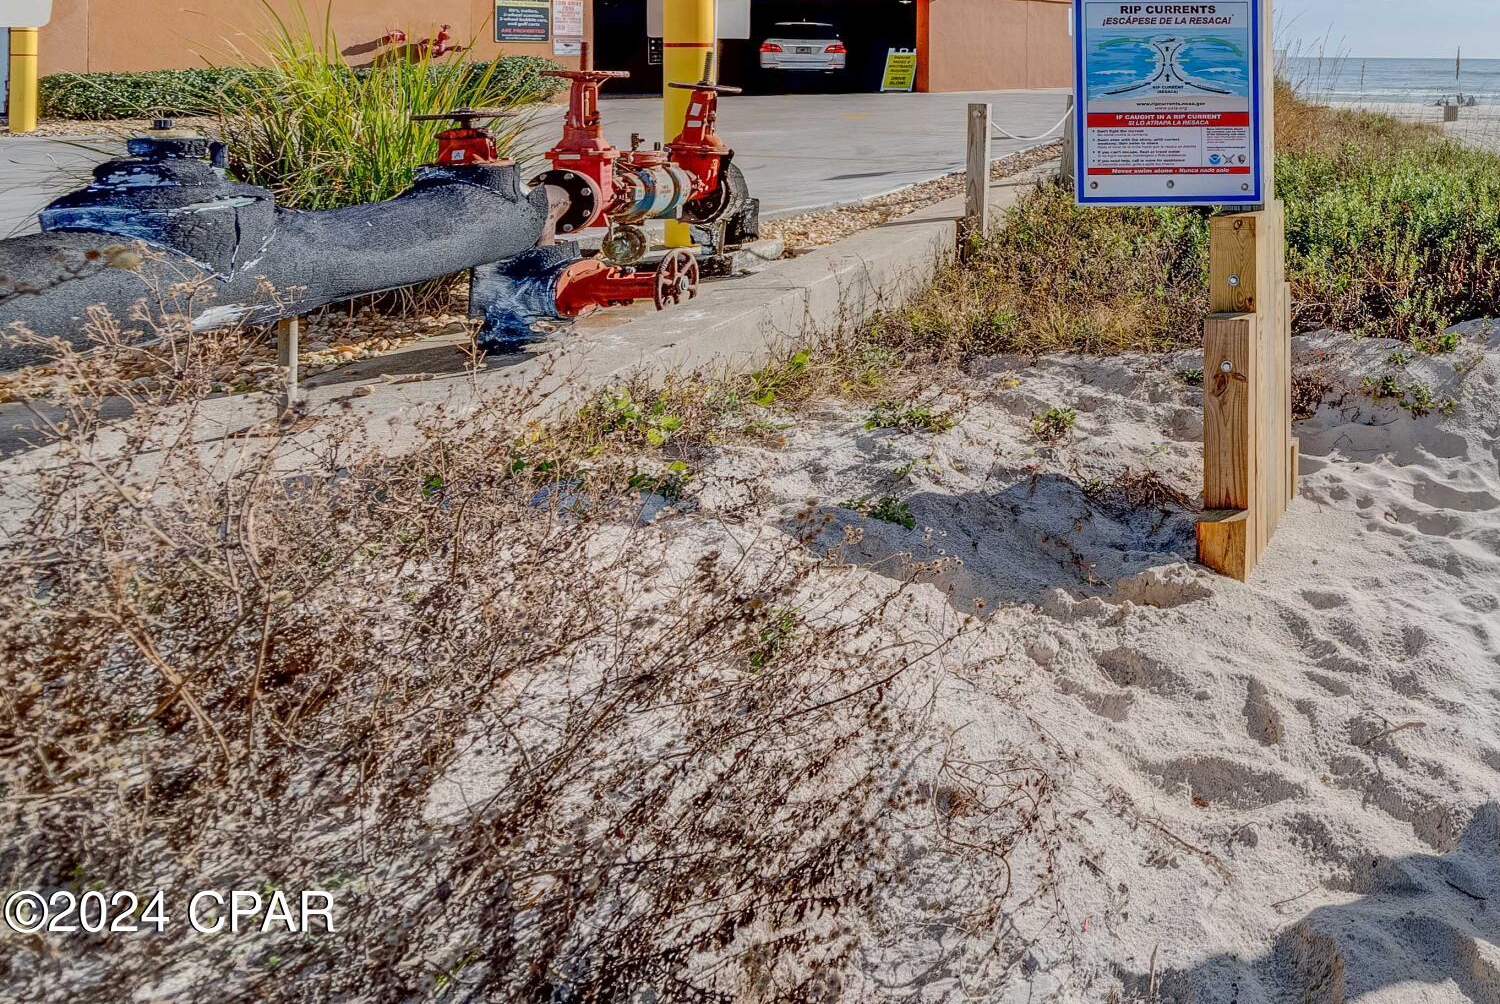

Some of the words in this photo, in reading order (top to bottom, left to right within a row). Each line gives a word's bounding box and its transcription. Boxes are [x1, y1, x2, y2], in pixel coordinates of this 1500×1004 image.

[1120, 6, 1141, 14] RIP
[1103, 16, 1156, 26] ¡ESCÁPESE
[1158, 16, 1172, 25] DE
[1174, 16, 1186, 25] LA
[1188, 16, 1231, 25] RESACA!
